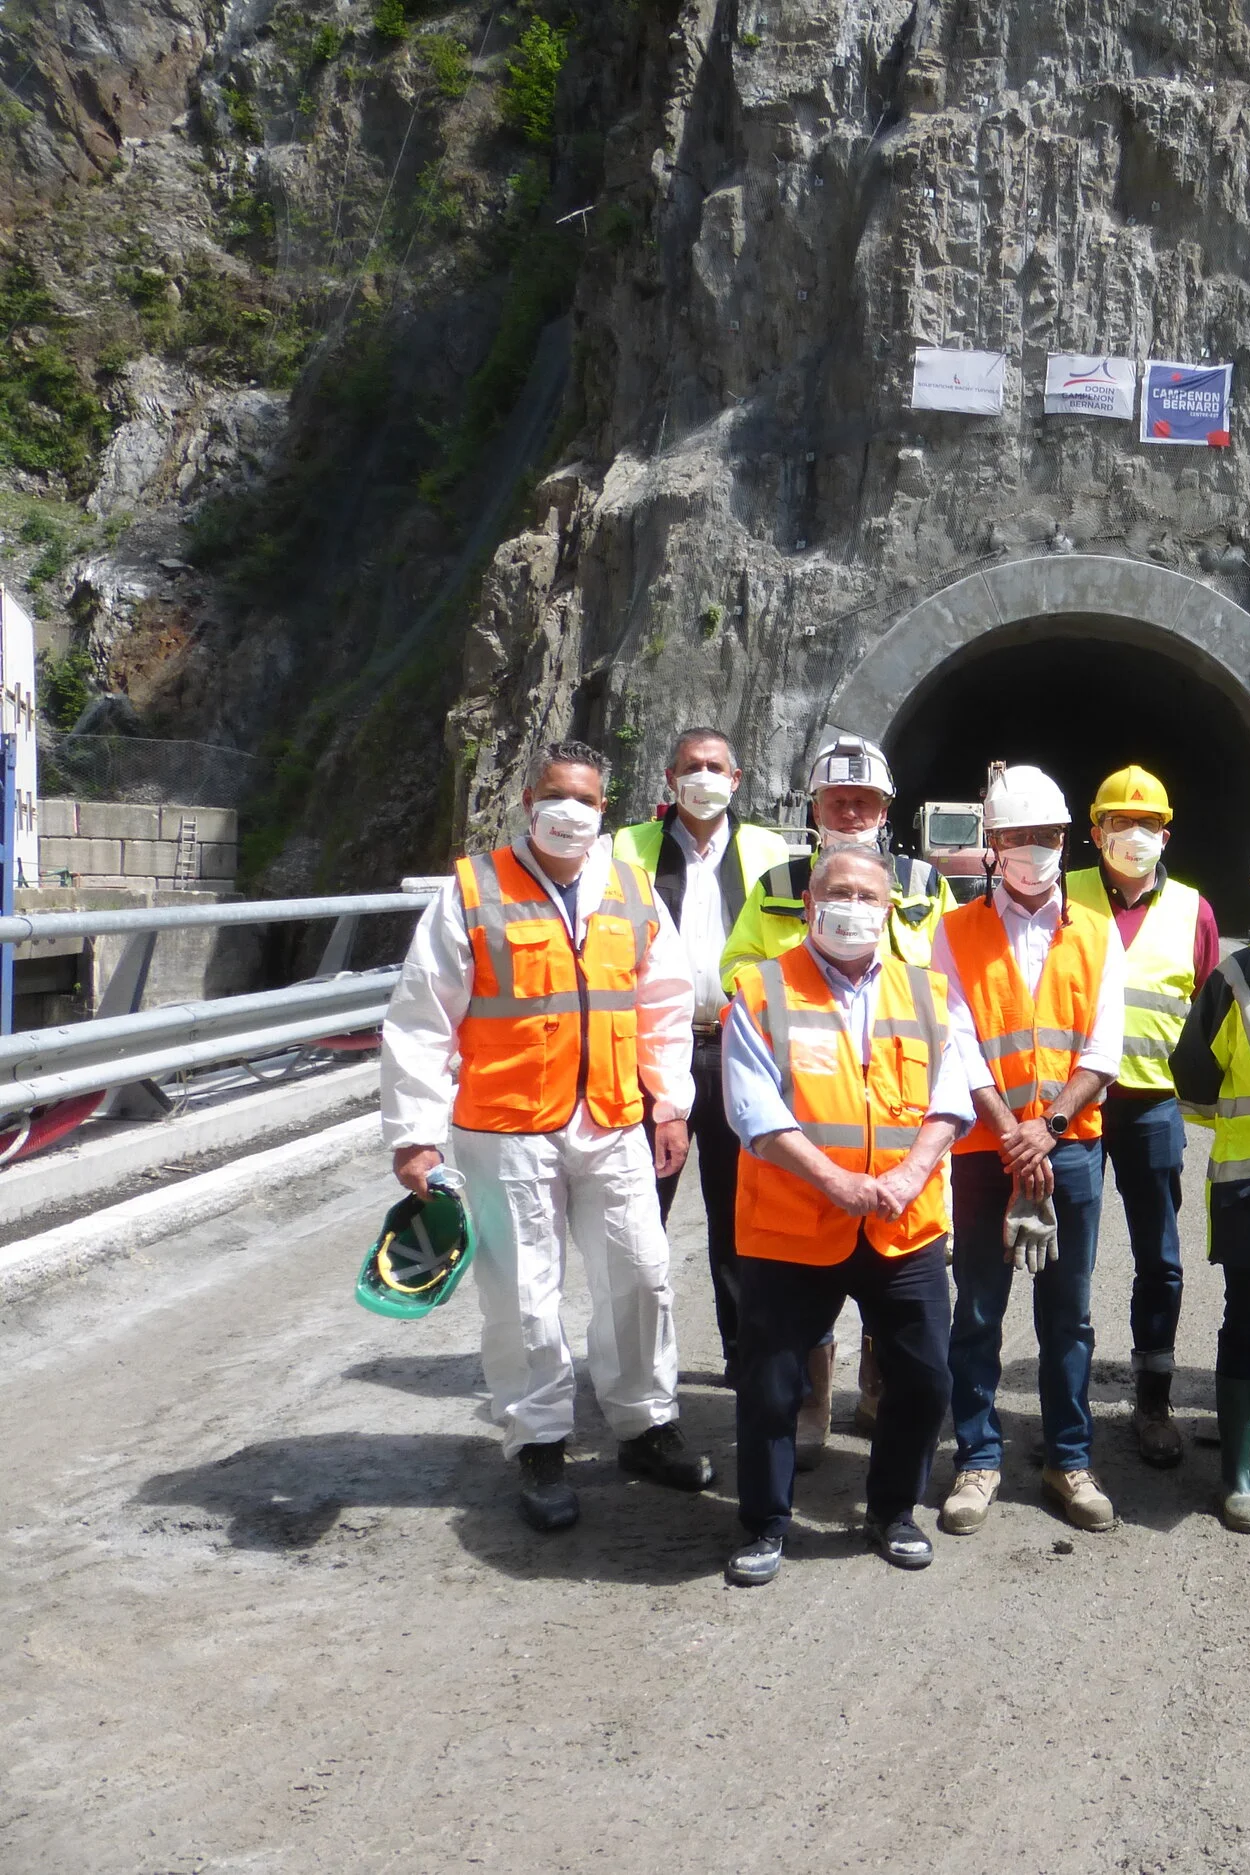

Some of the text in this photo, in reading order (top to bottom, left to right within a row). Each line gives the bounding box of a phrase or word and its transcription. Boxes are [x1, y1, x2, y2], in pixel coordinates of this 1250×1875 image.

[1084, 385, 1115, 395] DODIN
[1153, 388, 1220, 402] CAMPENON
[1061, 392, 1114, 403] CAMPENON
[1069, 400, 1113, 411] BERNARD
[1163, 399, 1220, 413] BERNARD
